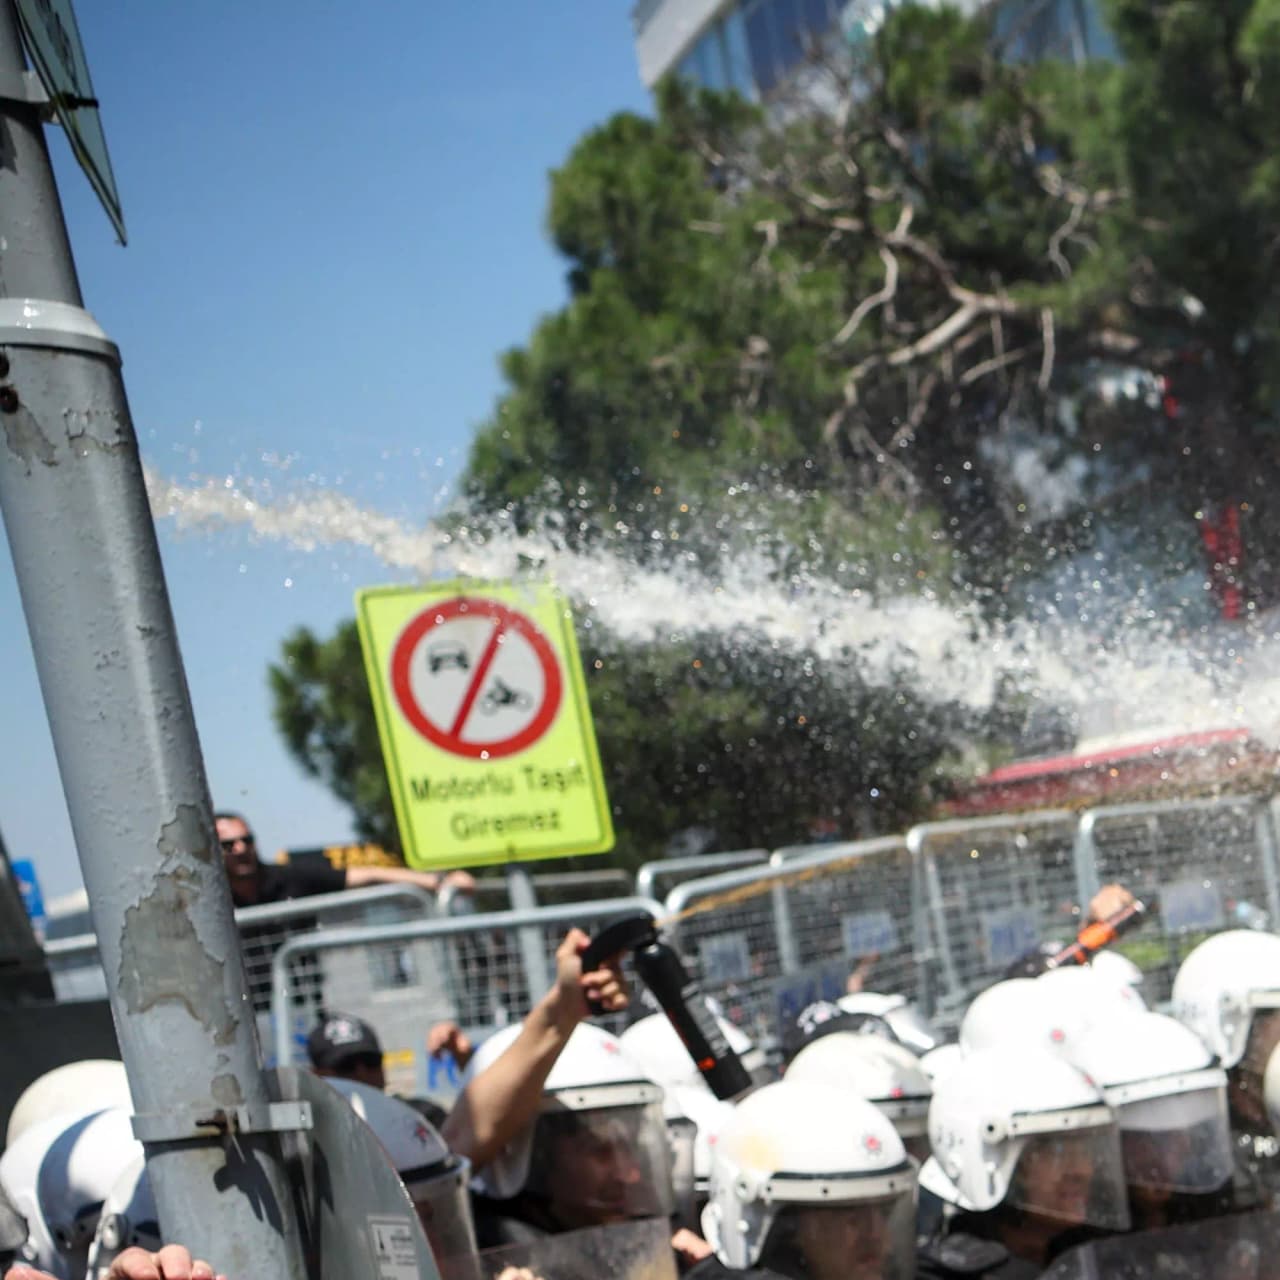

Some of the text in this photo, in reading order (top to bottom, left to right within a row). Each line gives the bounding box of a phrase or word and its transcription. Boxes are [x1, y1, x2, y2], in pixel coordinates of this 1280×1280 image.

[409, 763, 586, 802] Motorlu Taşıt
[450, 809, 562, 842] Giremez
